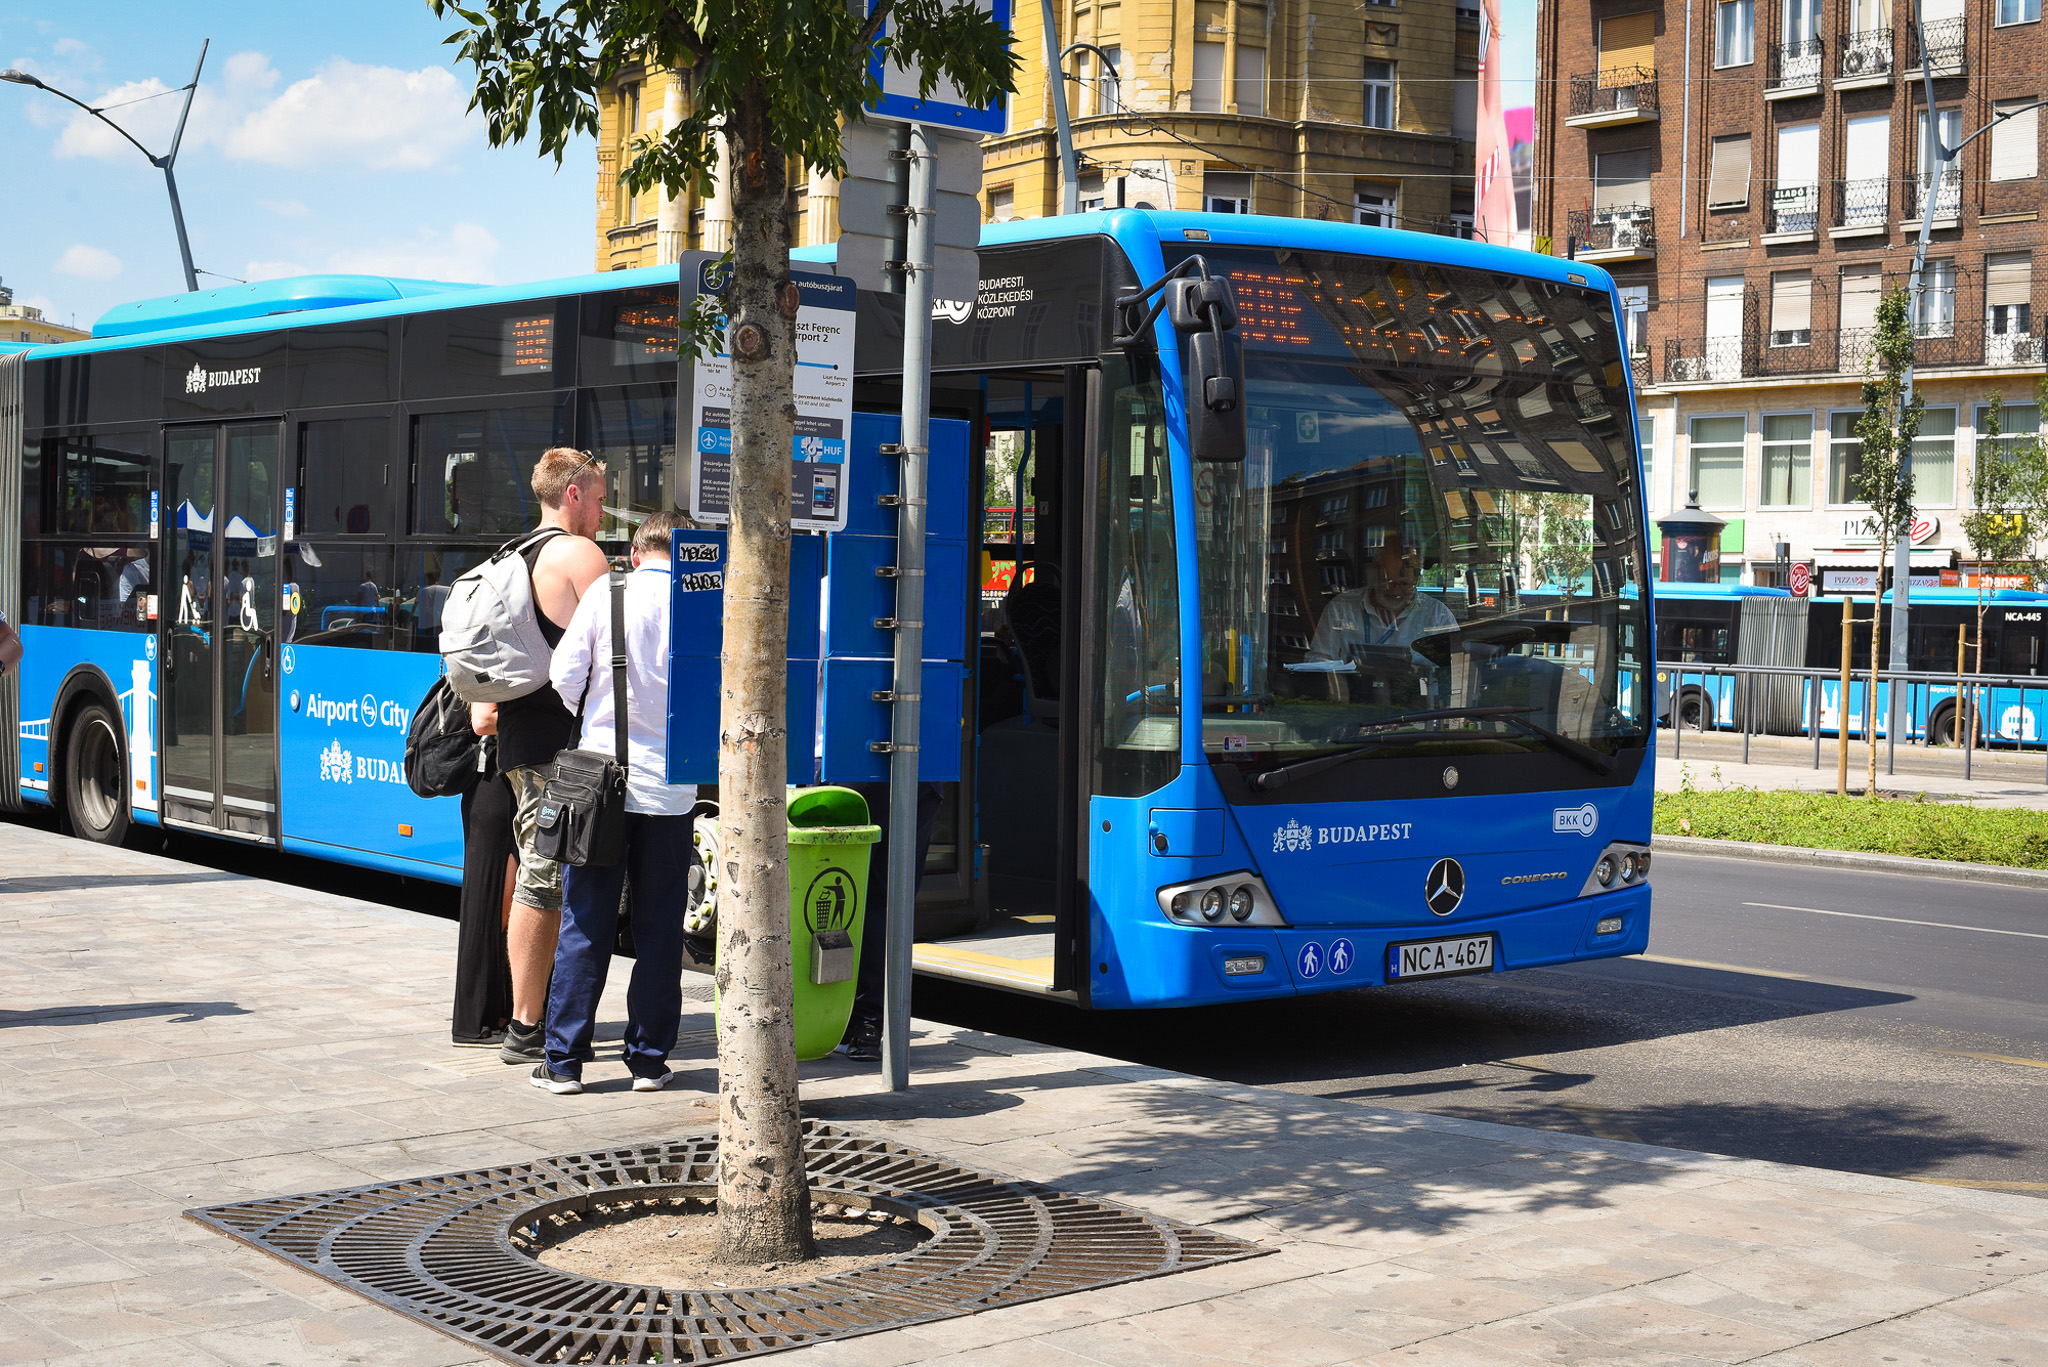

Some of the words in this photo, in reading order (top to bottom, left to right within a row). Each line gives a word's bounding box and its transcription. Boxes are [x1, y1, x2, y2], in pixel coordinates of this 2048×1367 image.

[1774, 187, 1805, 199] ELADÓ
[798, 280, 843, 293] autóbuszjárat
[978, 275, 1024, 291] BUDAPESTI
[978, 288, 1034, 305] KÖZLEKEDÉSI
[977, 305, 1017, 320] KÖZPONT
[796, 322, 810, 332] szt
[812, 322, 841, 335] Ferenc
[795, 331, 821, 343] irport
[823, 333, 829, 343] 2
[208, 367, 261, 388] BUDAPEST
[823, 445, 842, 456] HUF
[1979, 574, 2026, 592] change
[2005, 612, 2042, 622] NCA-445
[306, 693, 359, 726] Airport
[380, 700, 410, 735] City
[356, 756, 407, 785] BUDA
[1559, 815, 1579, 826] BKK
[1317, 822, 1412, 845] BUDAPEST
[1500, 871, 1568, 886] CONECTO
[1391, 964, 1398, 974] H
[1404, 940, 1489, 974] NCA-467
